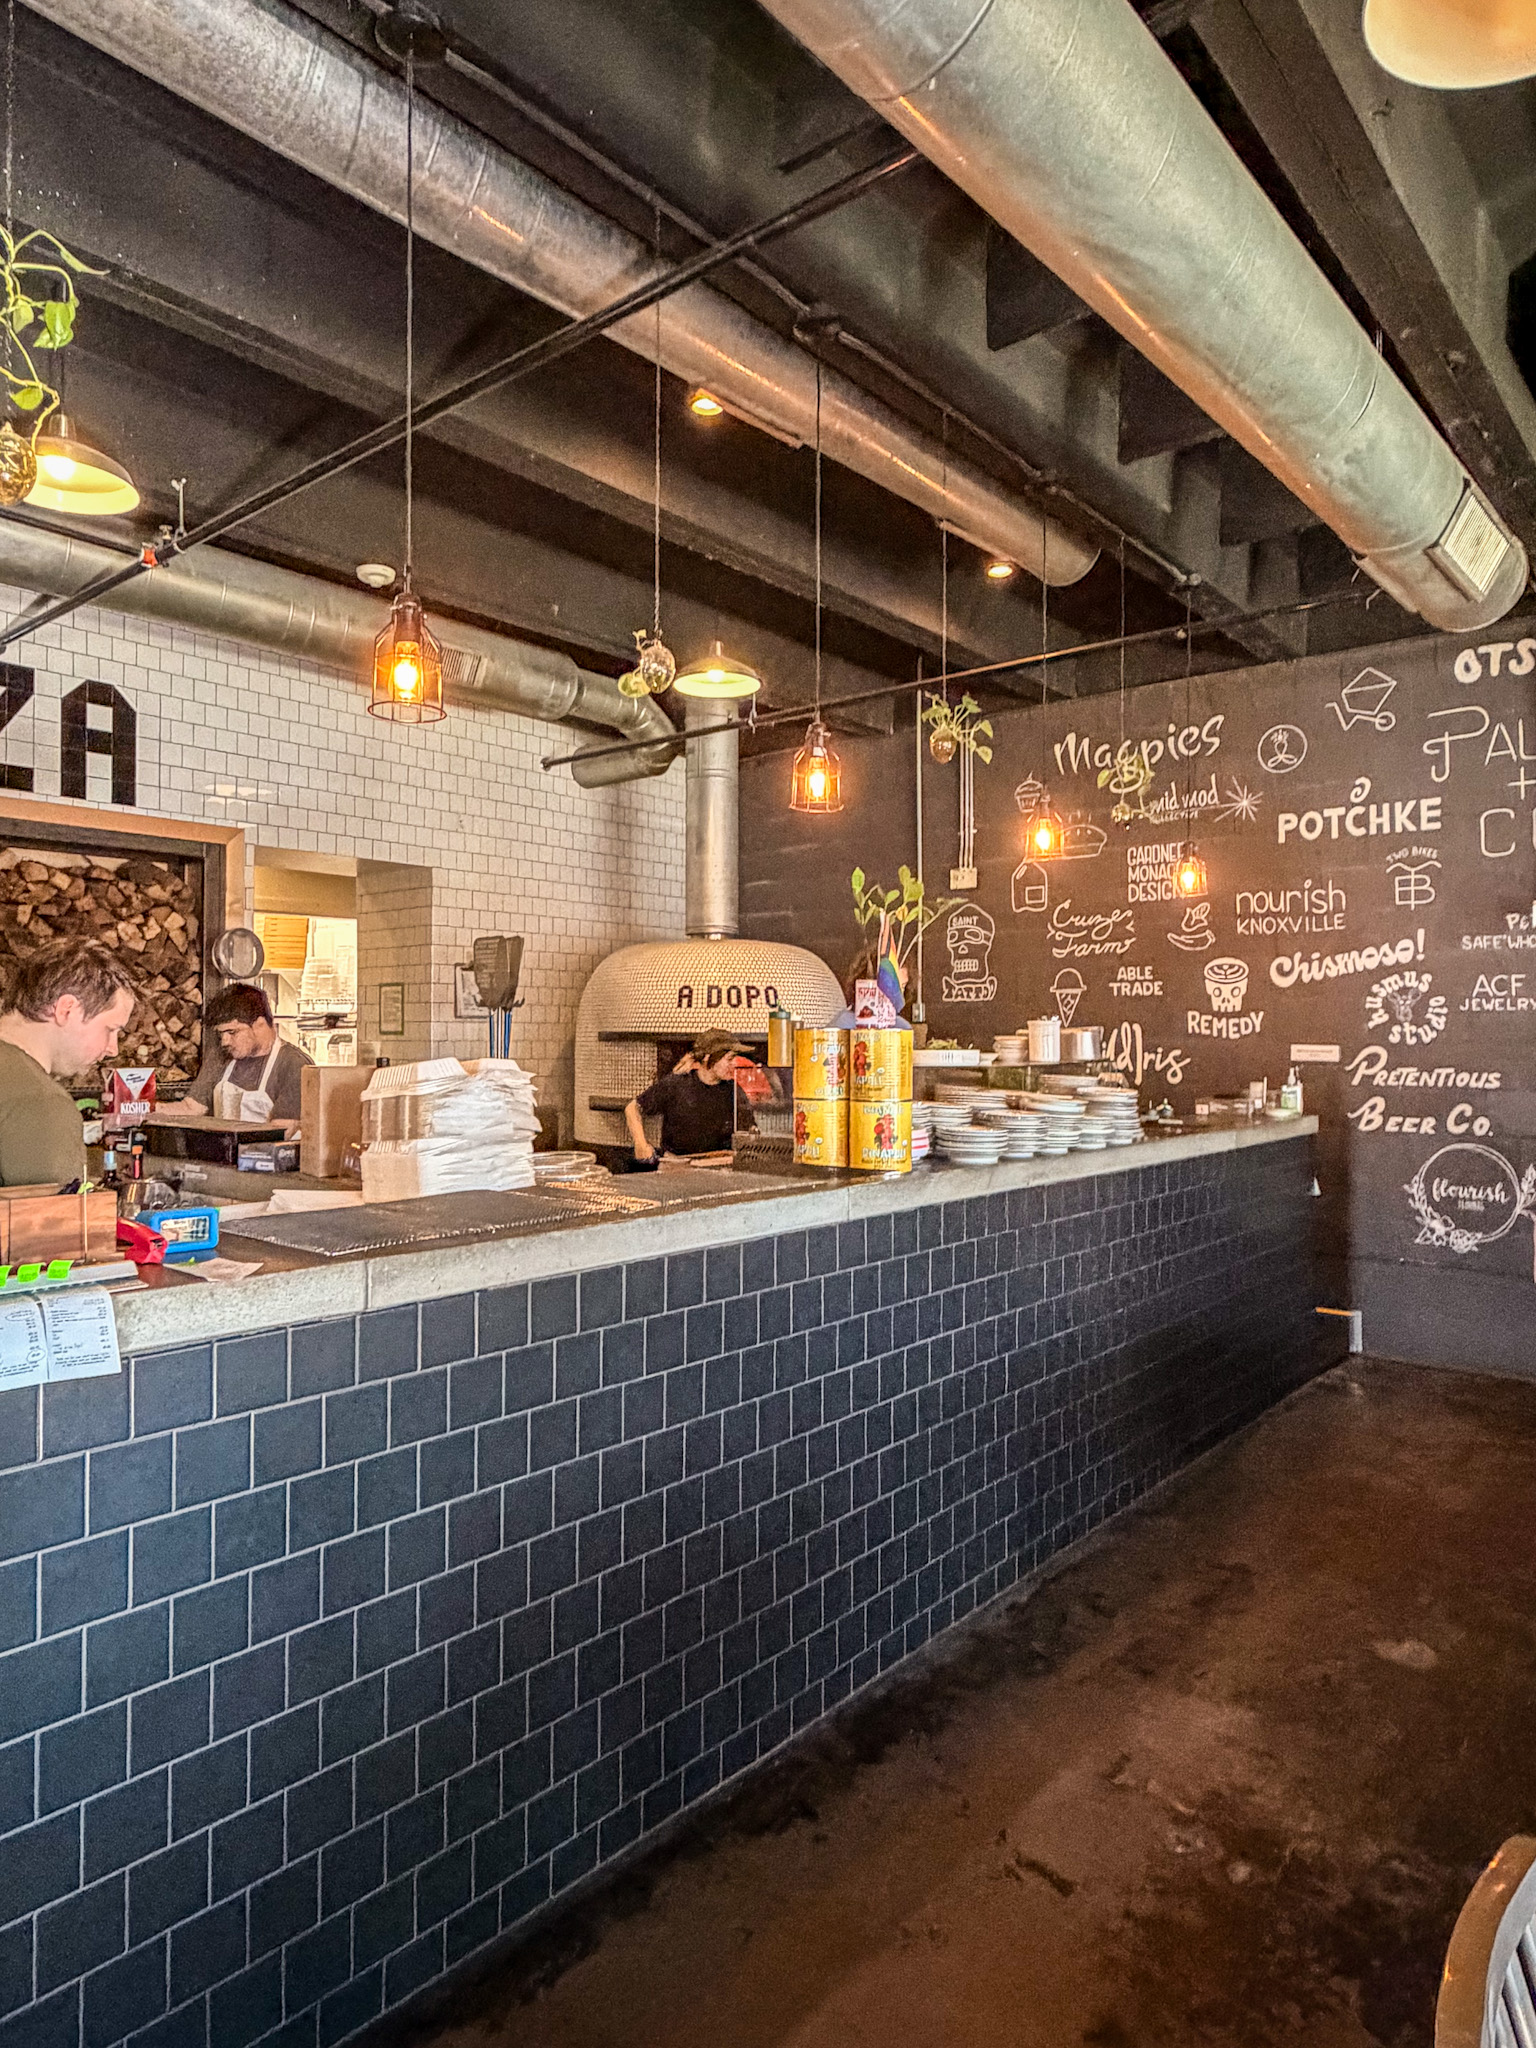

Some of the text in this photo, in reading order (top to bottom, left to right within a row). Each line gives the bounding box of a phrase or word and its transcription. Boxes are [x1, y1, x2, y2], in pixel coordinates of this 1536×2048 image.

[1053, 714, 1225, 794] Magpies
[1277, 796, 1442, 844] POTCHKE
[1236, 879, 1346, 915] nourish
[952, 915, 979, 927] SAINT
[1236, 912, 1346, 936] KNOXVILLE
[1269, 928, 1425, 988] Chismoso!
[1117, 965, 1153, 982] ABLE
[1472, 973, 1527, 998] ACF
[677, 985, 779, 1008] A DOPO
[1109, 981, 1164, 998] TRADE
[1187, 1011, 1264, 1040] REMEDY
[120, 1101, 151, 1115] KOSHER
